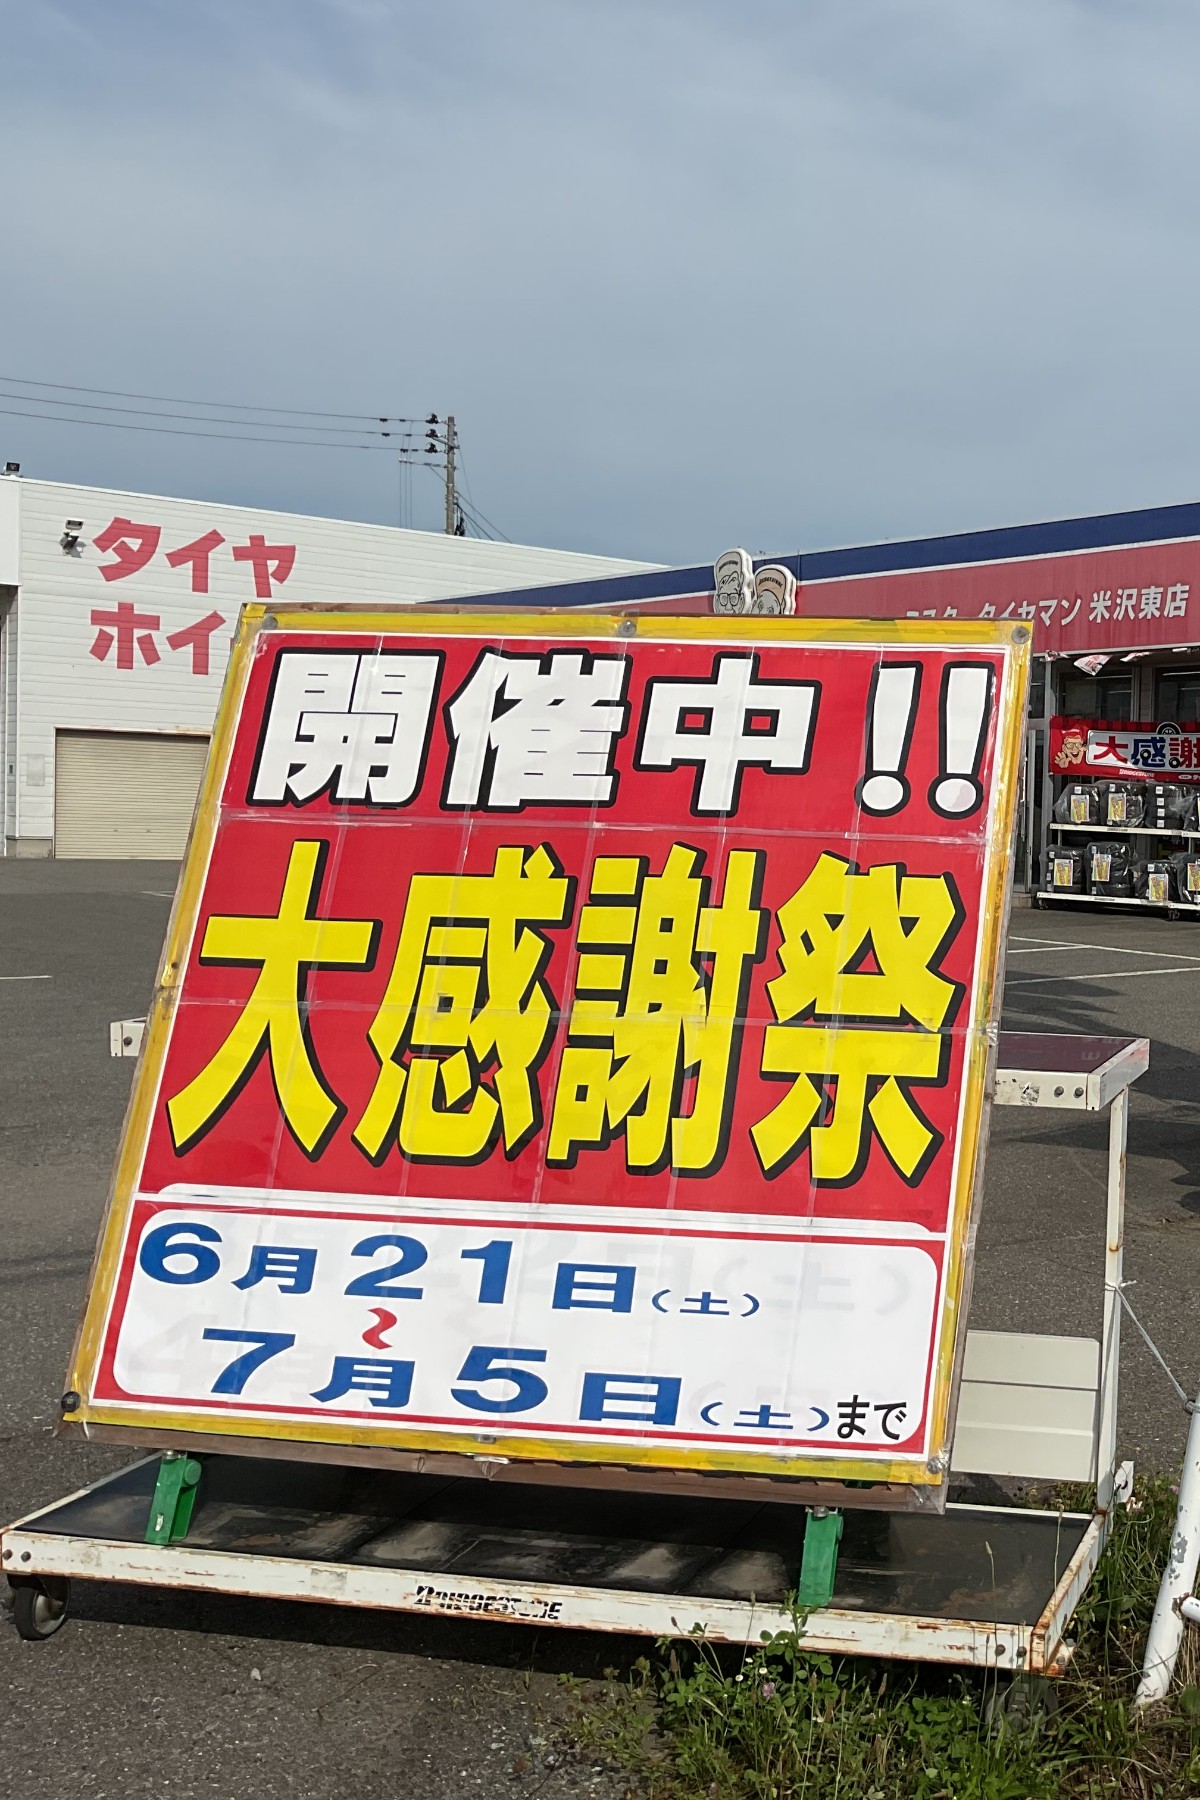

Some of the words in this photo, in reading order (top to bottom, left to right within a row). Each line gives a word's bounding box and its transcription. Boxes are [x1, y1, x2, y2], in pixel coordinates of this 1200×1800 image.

[93, 517, 297, 598] タイヤ
[90, 603, 234, 676] ホイ
[1088, 582, 1190, 624] 米沢東店
[166, 838, 968, 1189] 大感謝祭
